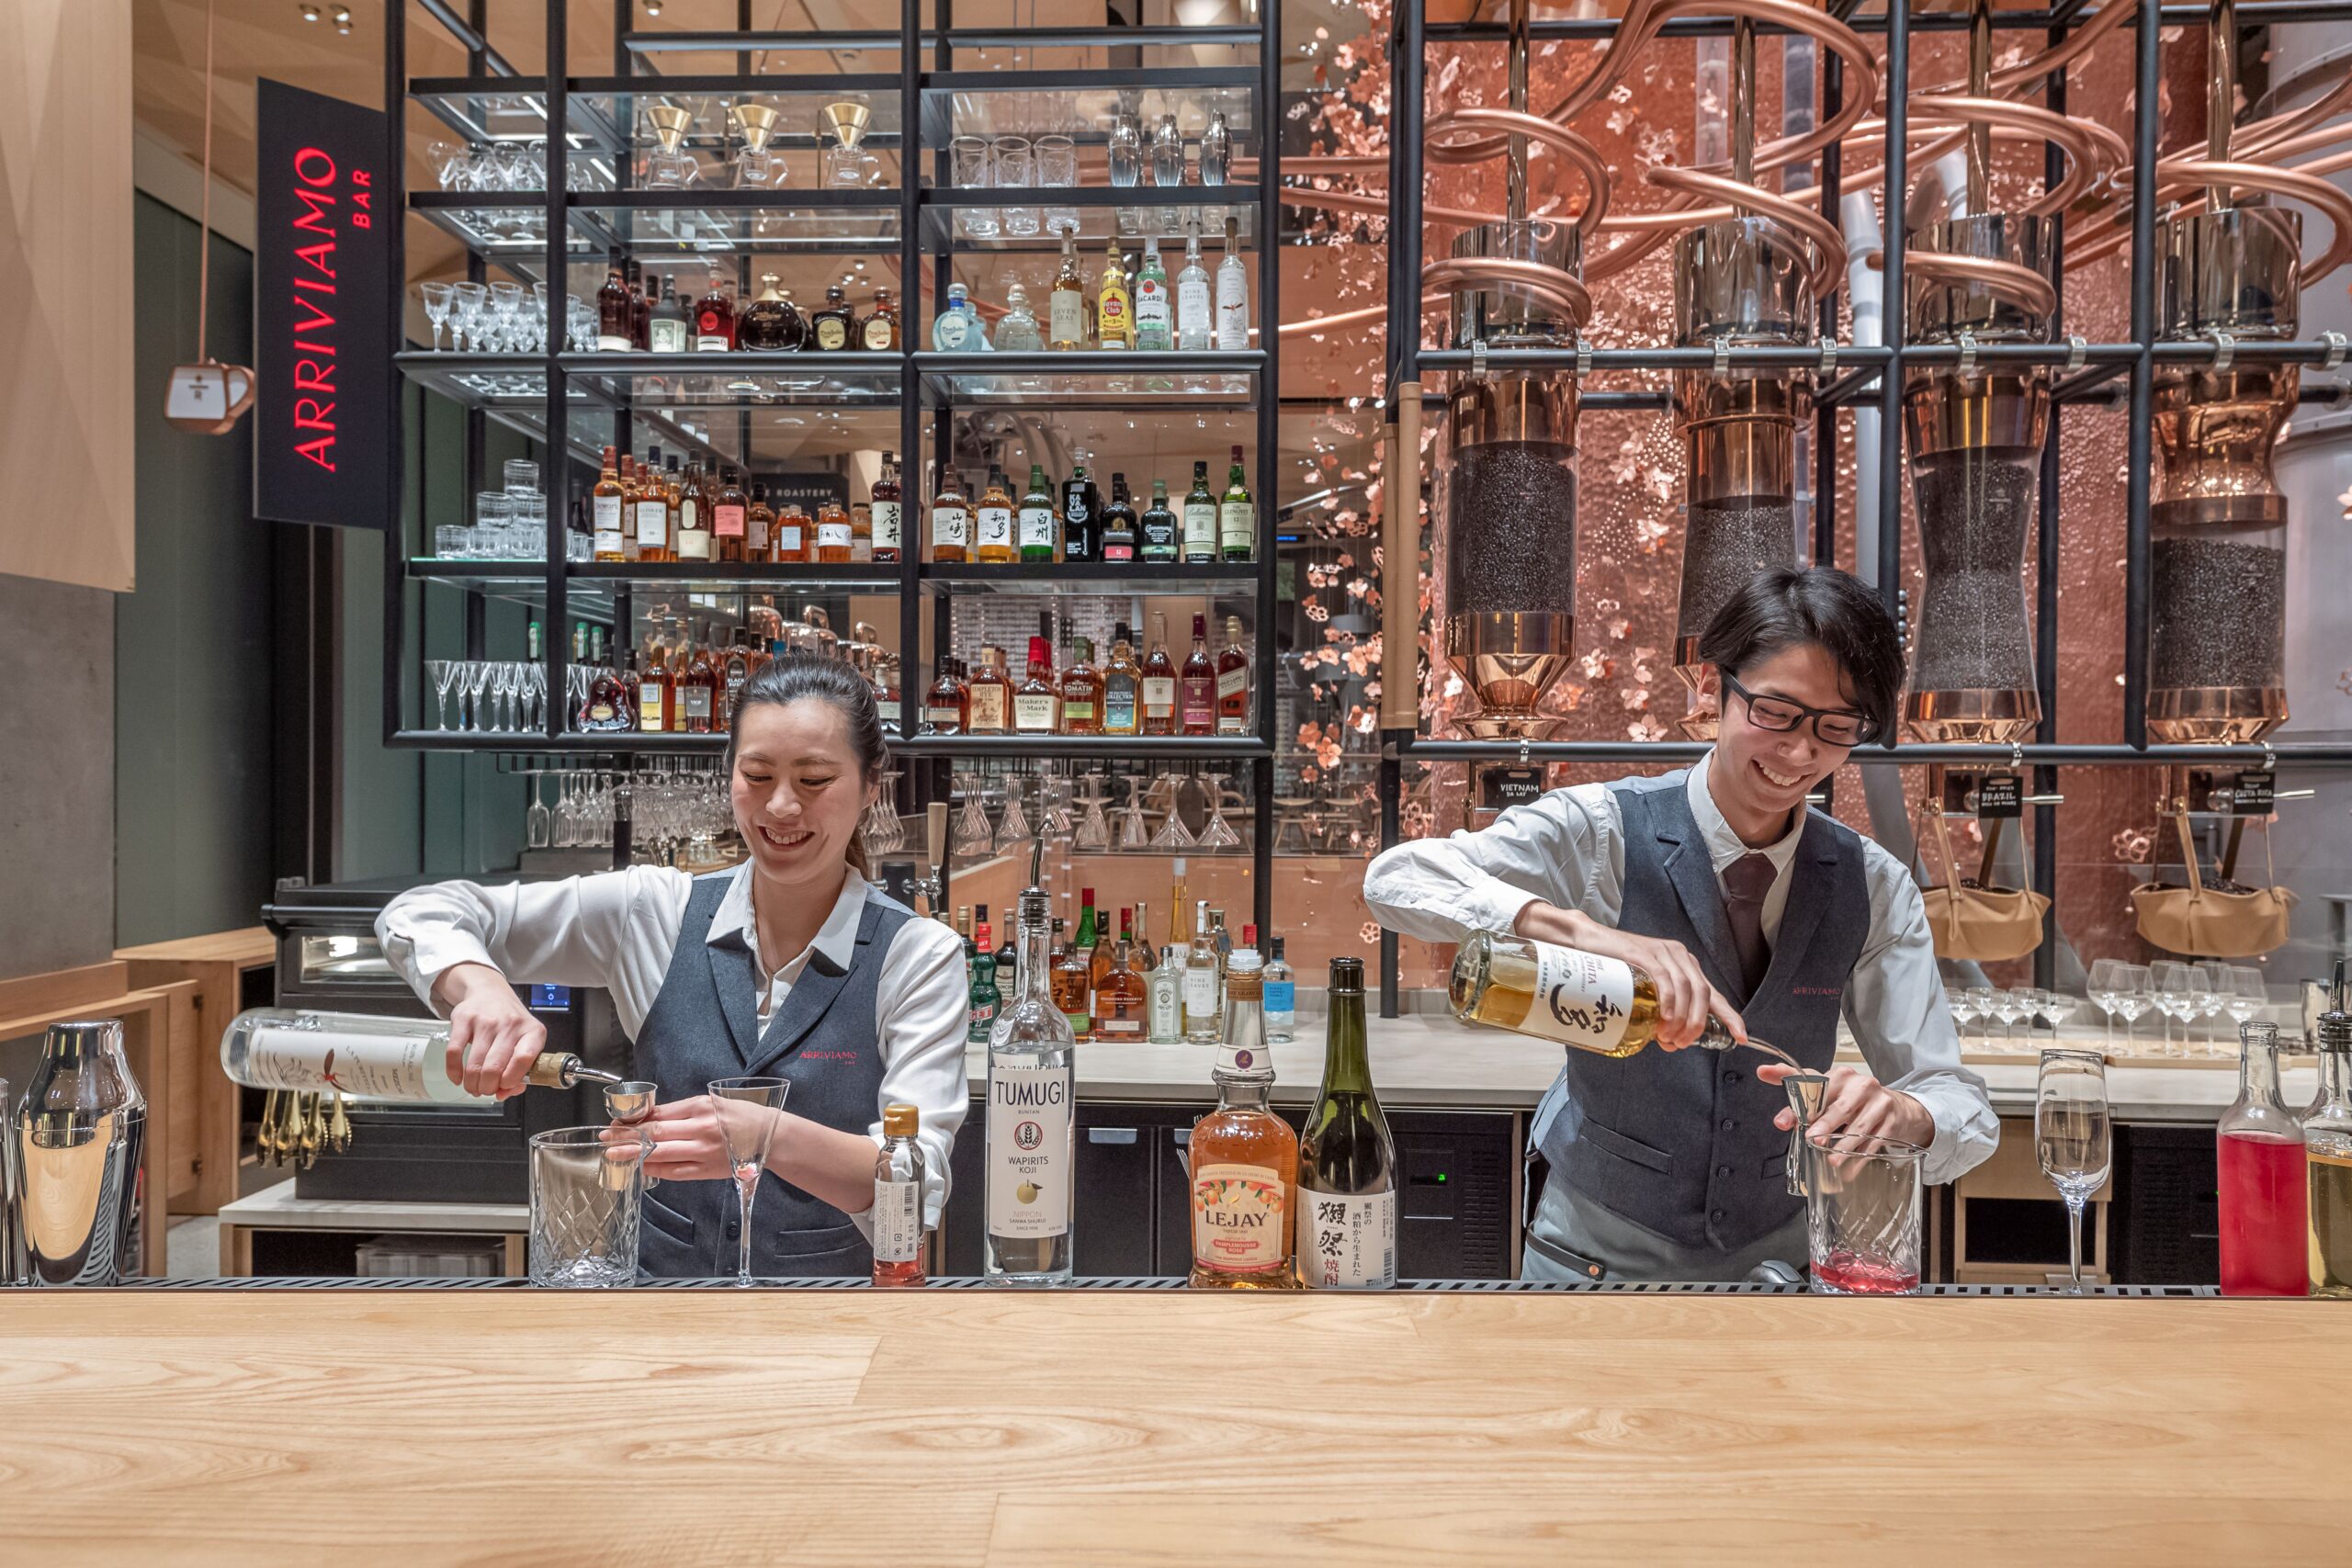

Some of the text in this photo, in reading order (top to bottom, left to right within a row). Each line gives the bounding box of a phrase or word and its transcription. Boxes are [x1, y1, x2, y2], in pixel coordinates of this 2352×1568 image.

[353, 169, 371, 229] BAR
[293, 147, 337, 472] ARRIVIAMO
[776, 489, 832, 498] ROASTERY
[949, 512, 964, 539] 山崎
[990, 511, 1006, 539] 知多
[1035, 513, 1048, 541] 白州
[1500, 784, 1539, 794] VIETNAM
[1981, 792, 2017, 802] BRAZIL
[1584, 955, 1598, 985] CHITA
[799, 1050, 858, 1059] ARRIVIAMO
[995, 1080, 1065, 1106] TUMUGI
[1008, 1156, 1049, 1166] WAPIRITS
[1205, 1210, 1268, 1227] LEJAY
